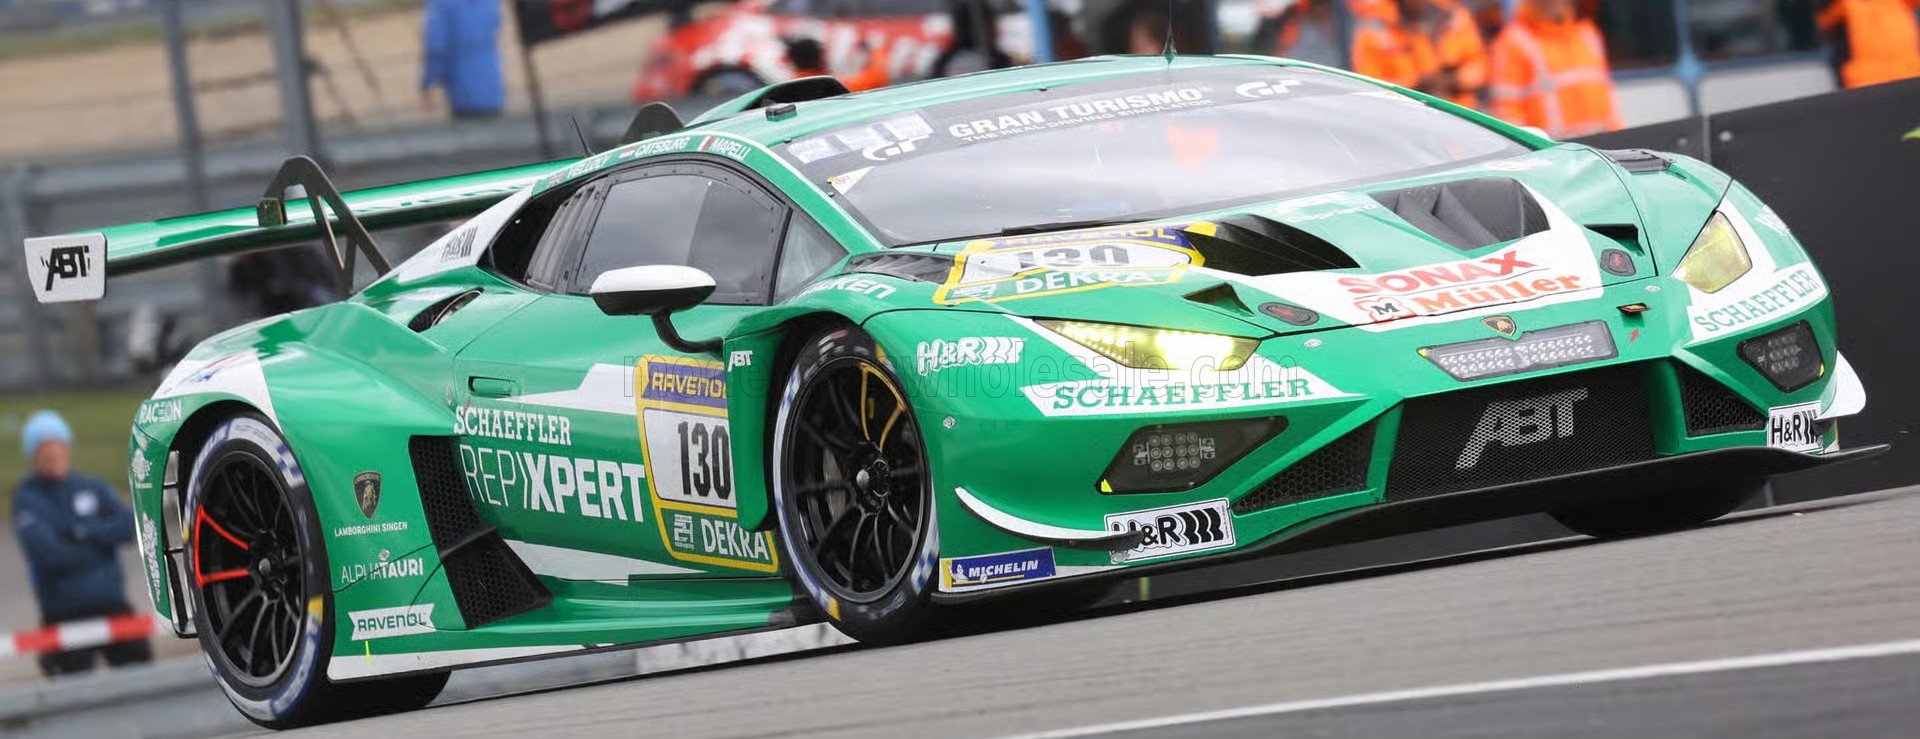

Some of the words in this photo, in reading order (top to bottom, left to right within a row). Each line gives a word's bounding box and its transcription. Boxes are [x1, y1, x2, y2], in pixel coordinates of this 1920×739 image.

[949, 110, 1046, 138] GRAN
[1047, 87, 1203, 120] TURISMO
[962, 132, 999, 142] THE
[1000, 125, 1046, 136] REAL
[1046, 112, 1115, 128] DRIVING
[1117, 99, 1215, 117] SIMULATOR
[635, 136, 691, 157] CATSBURG
[708, 137, 750, 161] MAPELLI
[46, 245, 90, 291] ABT
[1015, 270, 1155, 295] DEKRA
[1338, 250, 1538, 294] SONAX
[1411, 272, 1583, 313] Müller
[1694, 269, 1821, 332] SCHAEFFLER
[728, 350, 753, 372] ABT
[917, 337, 982, 377] H&R
[1053, 377, 1313, 410] SCHAEFFLER
[454, 405, 572, 446] SCHAEFFLER
[1456, 387, 1589, 470] ABT
[1771, 413, 1802, 445] H&R
[678, 421, 732, 500] 130
[334, 524, 381, 537] LAMBORGHINI
[381, 521, 408, 533] SINGEN
[701, 518, 770, 561] DEKRA
[341, 557, 424, 584] ALPHATAURI
[969, 559, 1039, 578] MICHELIN
[357, 612, 427, 632] RAVENOL
